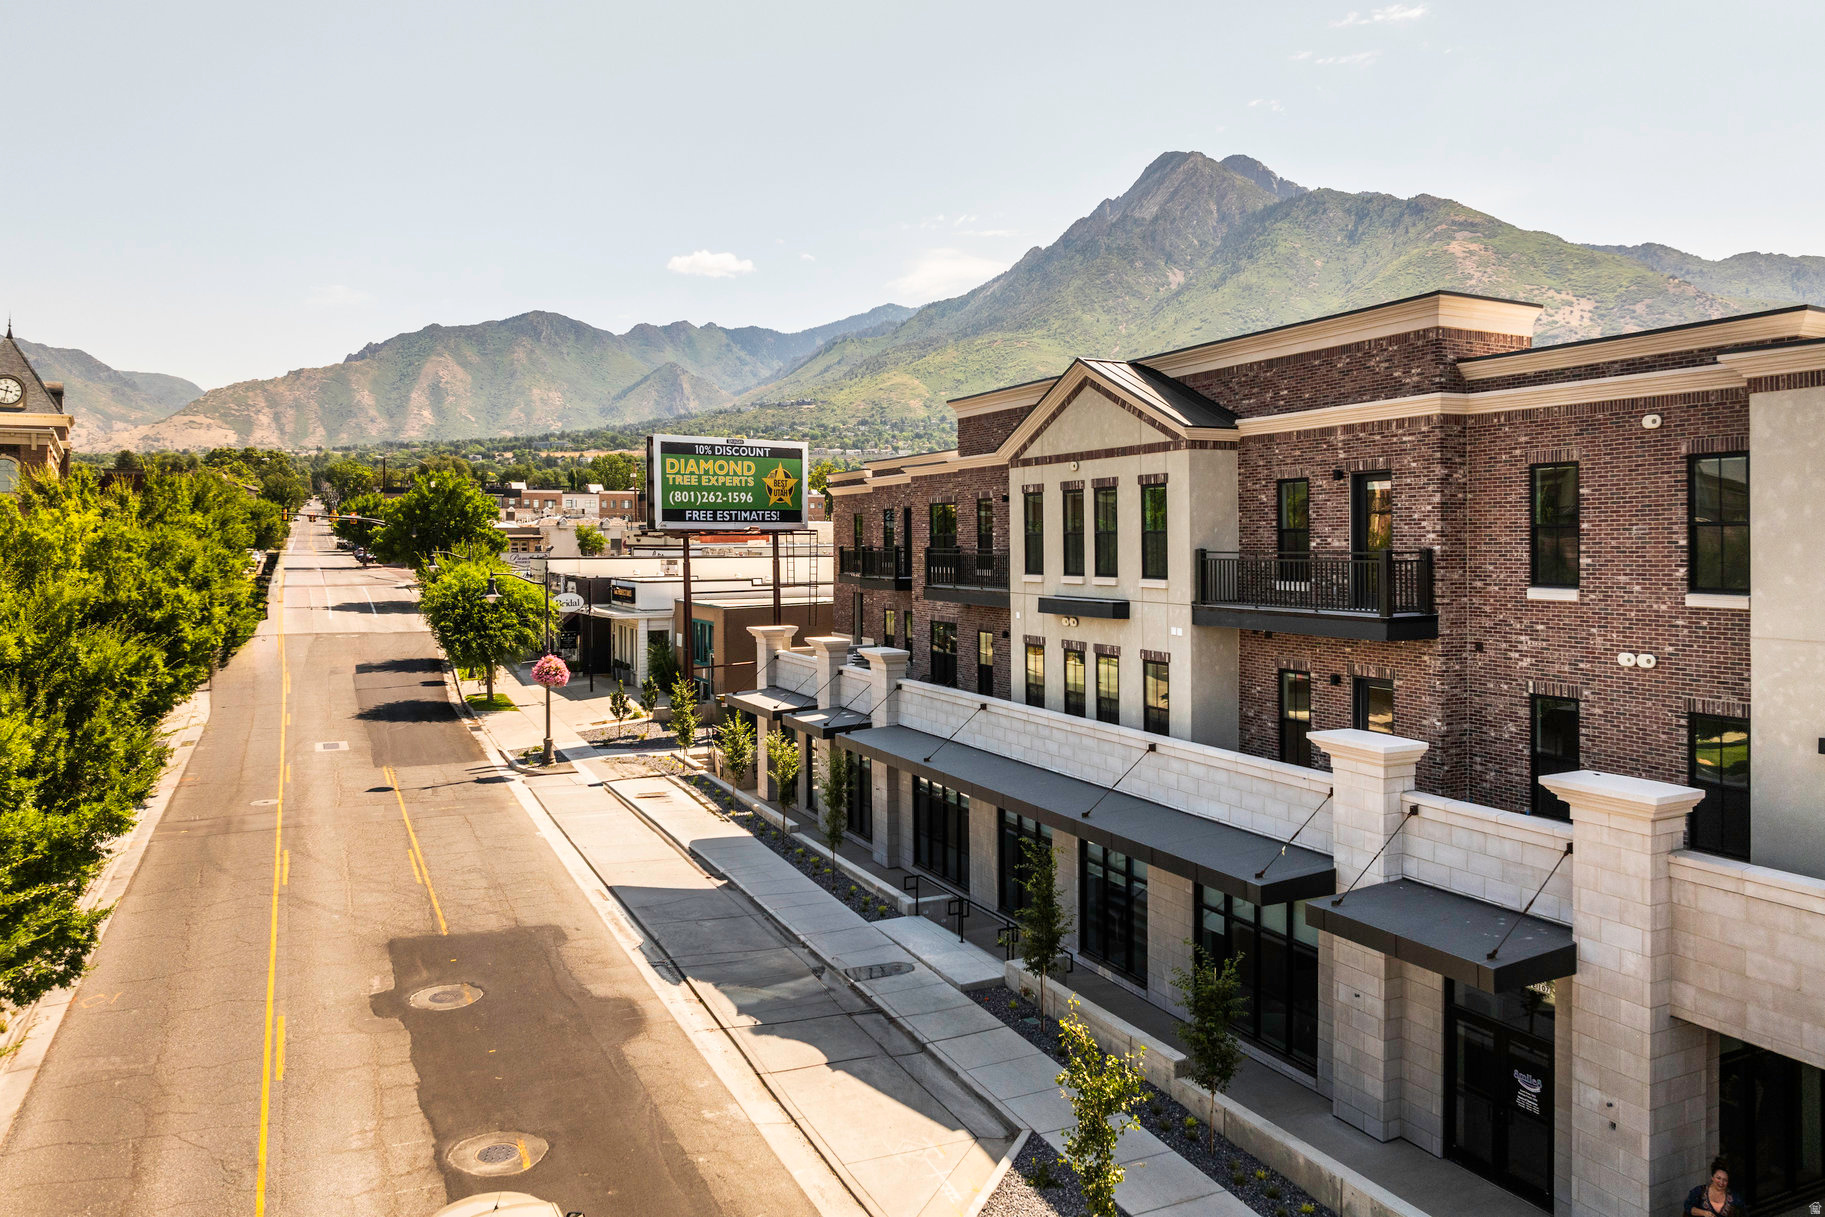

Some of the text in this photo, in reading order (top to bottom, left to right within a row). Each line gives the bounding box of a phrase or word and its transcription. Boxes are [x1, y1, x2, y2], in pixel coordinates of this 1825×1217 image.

[694, 445, 771, 457] 10% DISCOUNT
[665, 458, 756, 475] DIAMOND
[666, 475, 755, 486] TREE EXPERTS
[773, 479, 788, 488] BEST
[669, 491, 753, 506] (801)262-1596
[773, 489, 788, 497] UTAH
[685, 510, 780, 521] FREE ESTIMATES!
